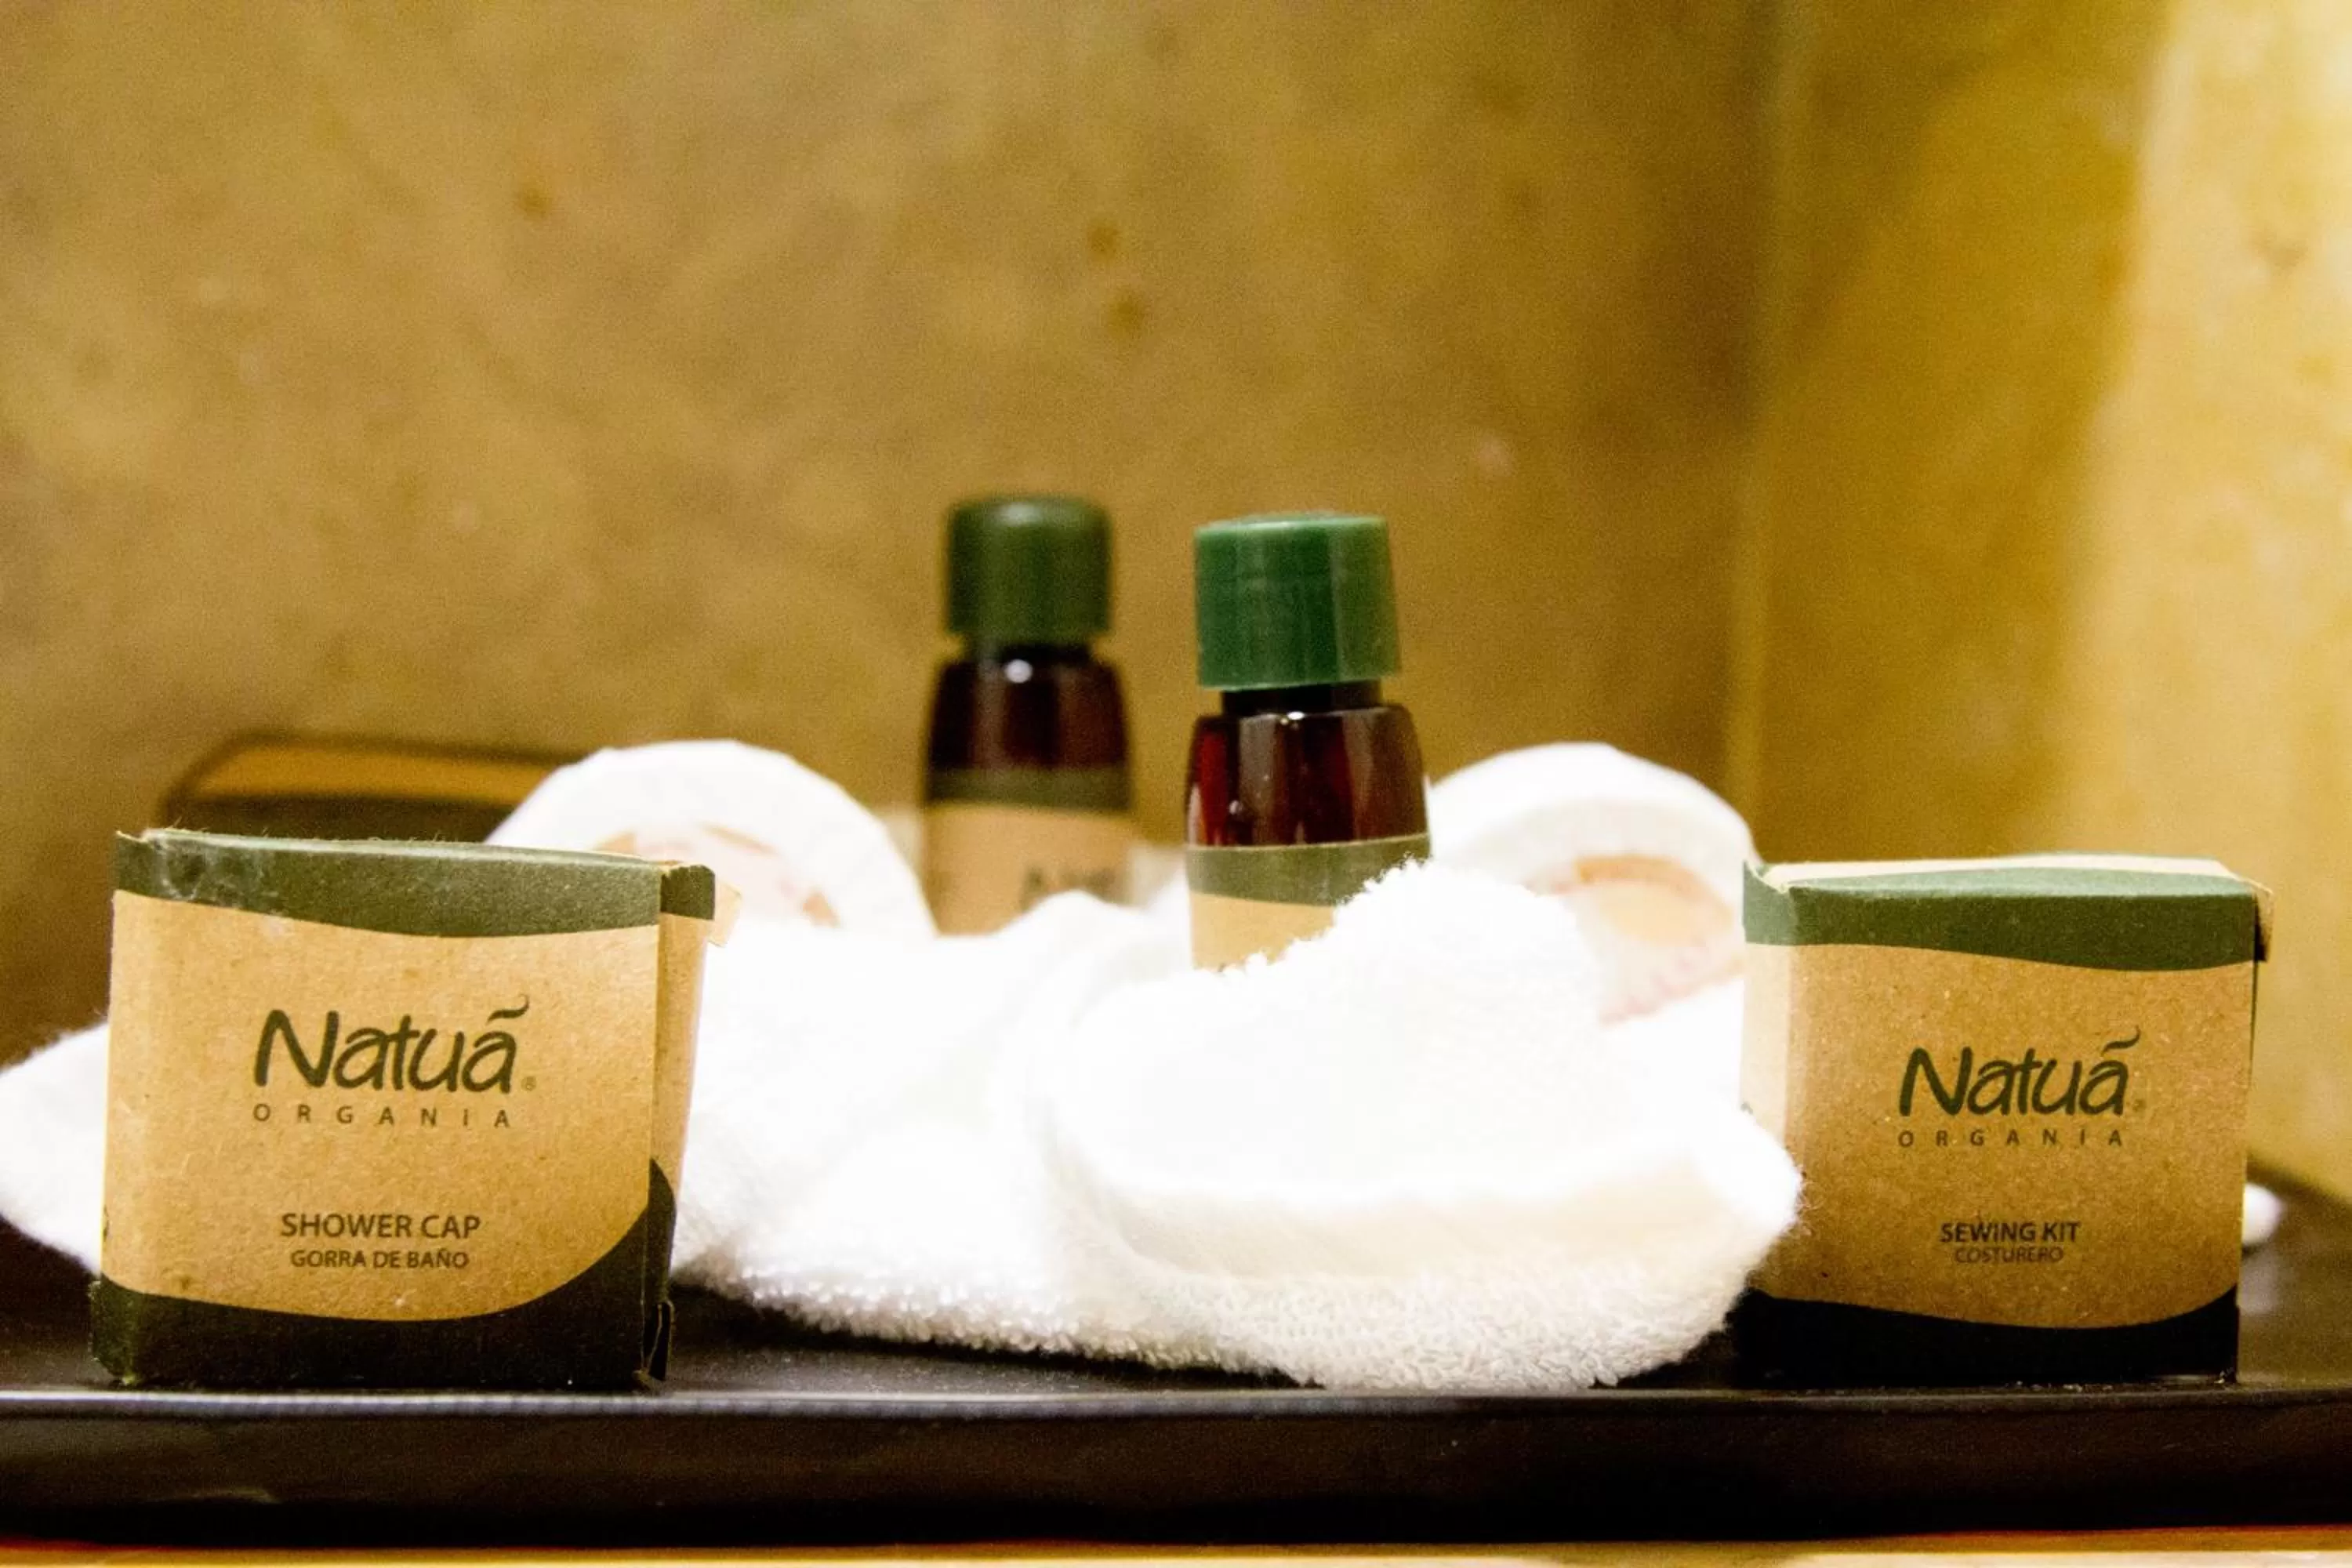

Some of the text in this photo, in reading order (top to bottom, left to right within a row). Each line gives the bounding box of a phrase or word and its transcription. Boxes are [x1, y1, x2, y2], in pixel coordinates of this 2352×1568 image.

[252, 1102, 510, 1129] ORGANIA
[1897, 1128, 2123, 1149] ORGANIA
[281, 1212, 481, 1240] SHOWER CAP
[1940, 1221, 2081, 1243] SEWING KIT
[290, 1247, 470, 1269] GORRA DE BAÑO
[1955, 1245, 2065, 1264] COSTURERO
